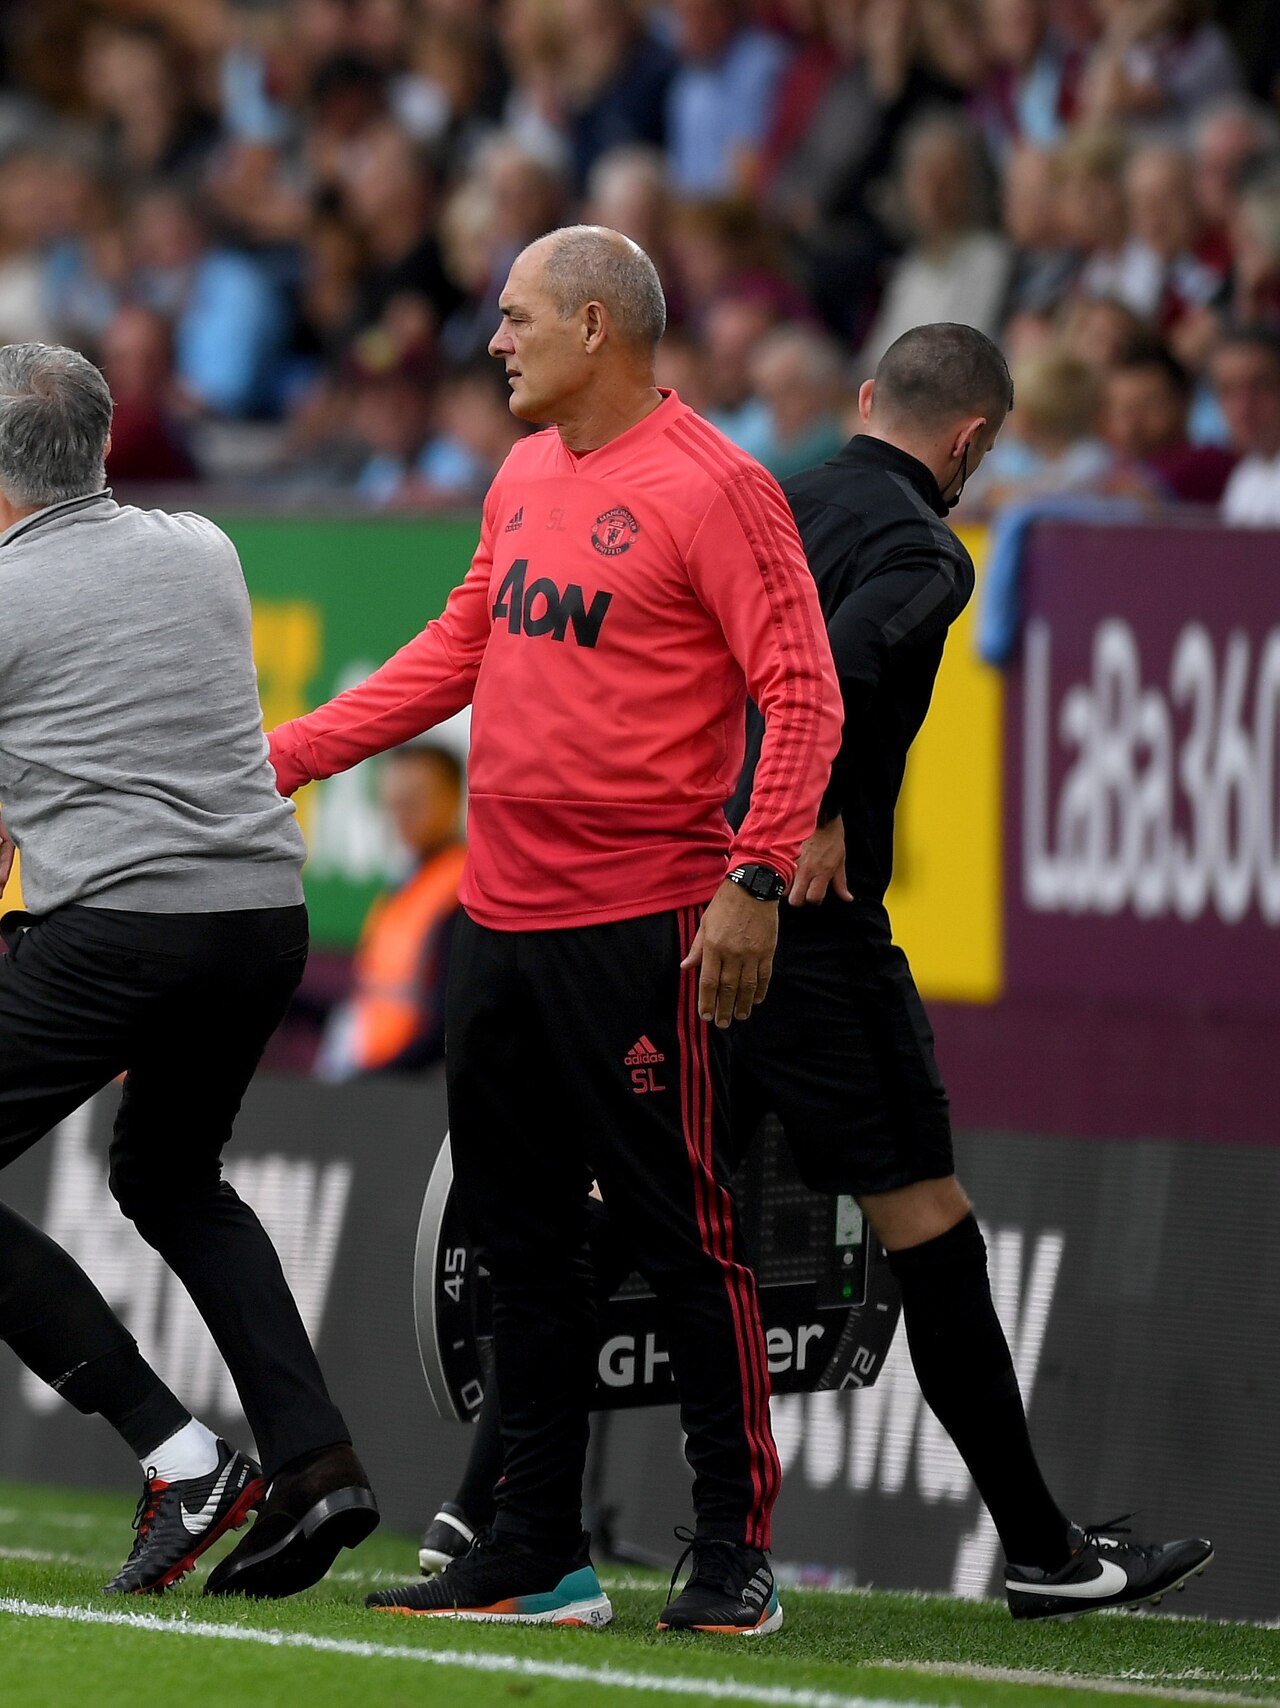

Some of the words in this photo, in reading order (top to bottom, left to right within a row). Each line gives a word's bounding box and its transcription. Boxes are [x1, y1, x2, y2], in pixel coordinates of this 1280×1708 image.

[624, 1053, 665, 1066] adidas
[631, 1067, 666, 1094] SL
[444, 1247, 466, 1303] 45
